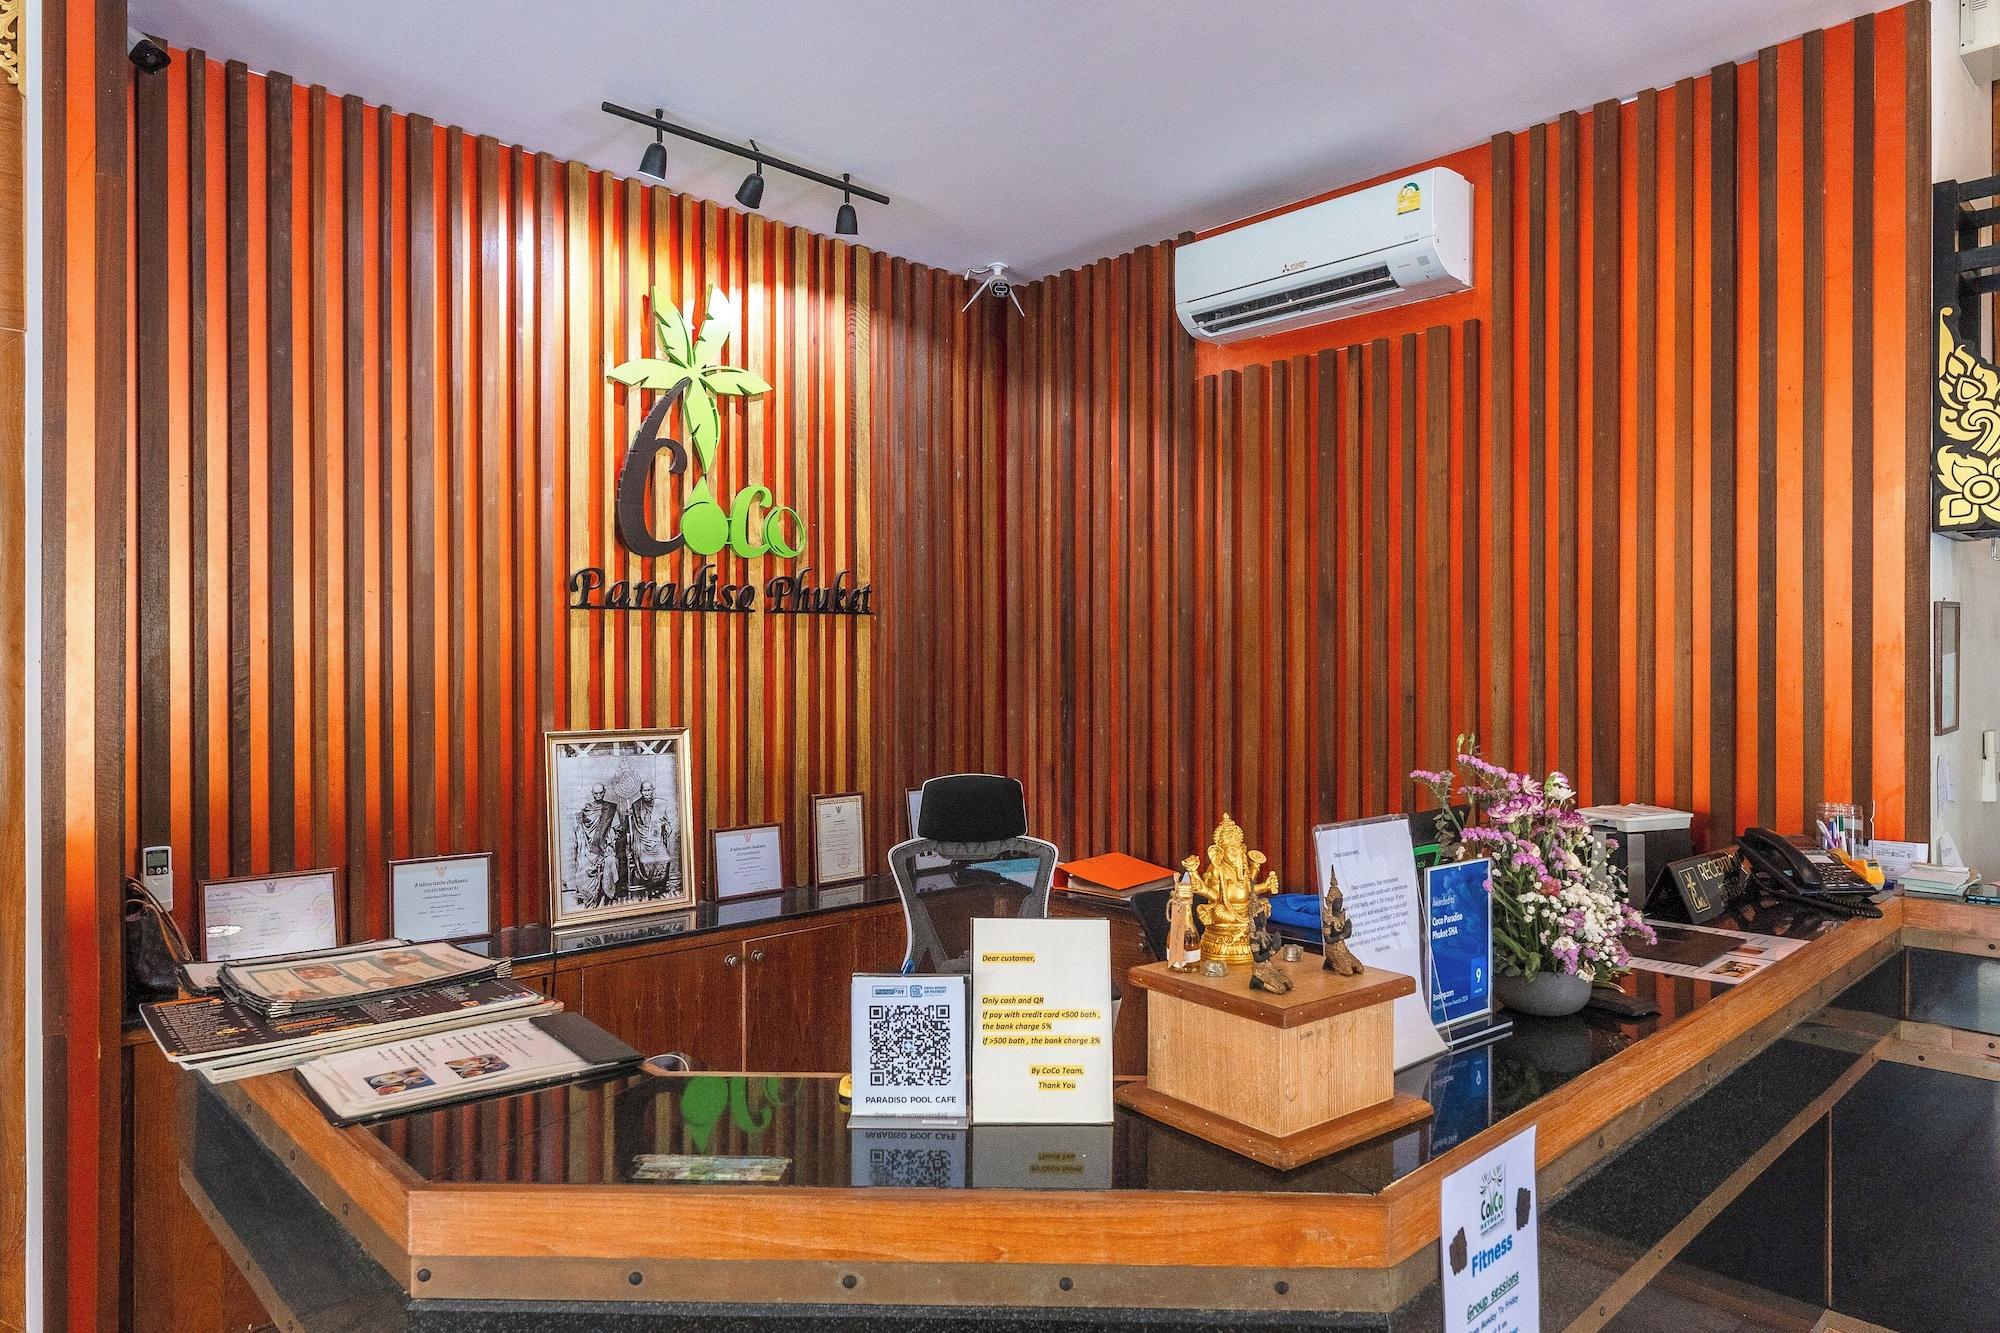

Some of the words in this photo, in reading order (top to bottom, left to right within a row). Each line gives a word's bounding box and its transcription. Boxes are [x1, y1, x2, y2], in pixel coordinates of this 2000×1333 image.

[766, 567, 873, 612] Phuket
[1448, 926, 1458, 936] SHA
[1476, 968, 1482, 984] 9
[982, 1011, 988, 1019] If
[1015, 1023, 1040, 1031] charge
[1064, 1037, 1088, 1046] charge
[1031, 1067, 1040, 1075] By
[1062, 1067, 1084, 1075] Team,
[1472, 1234, 1512, 1278] Fitness
[1467, 1296, 1489, 1320] Group
[1491, 1271, 1519, 1300] sessions
